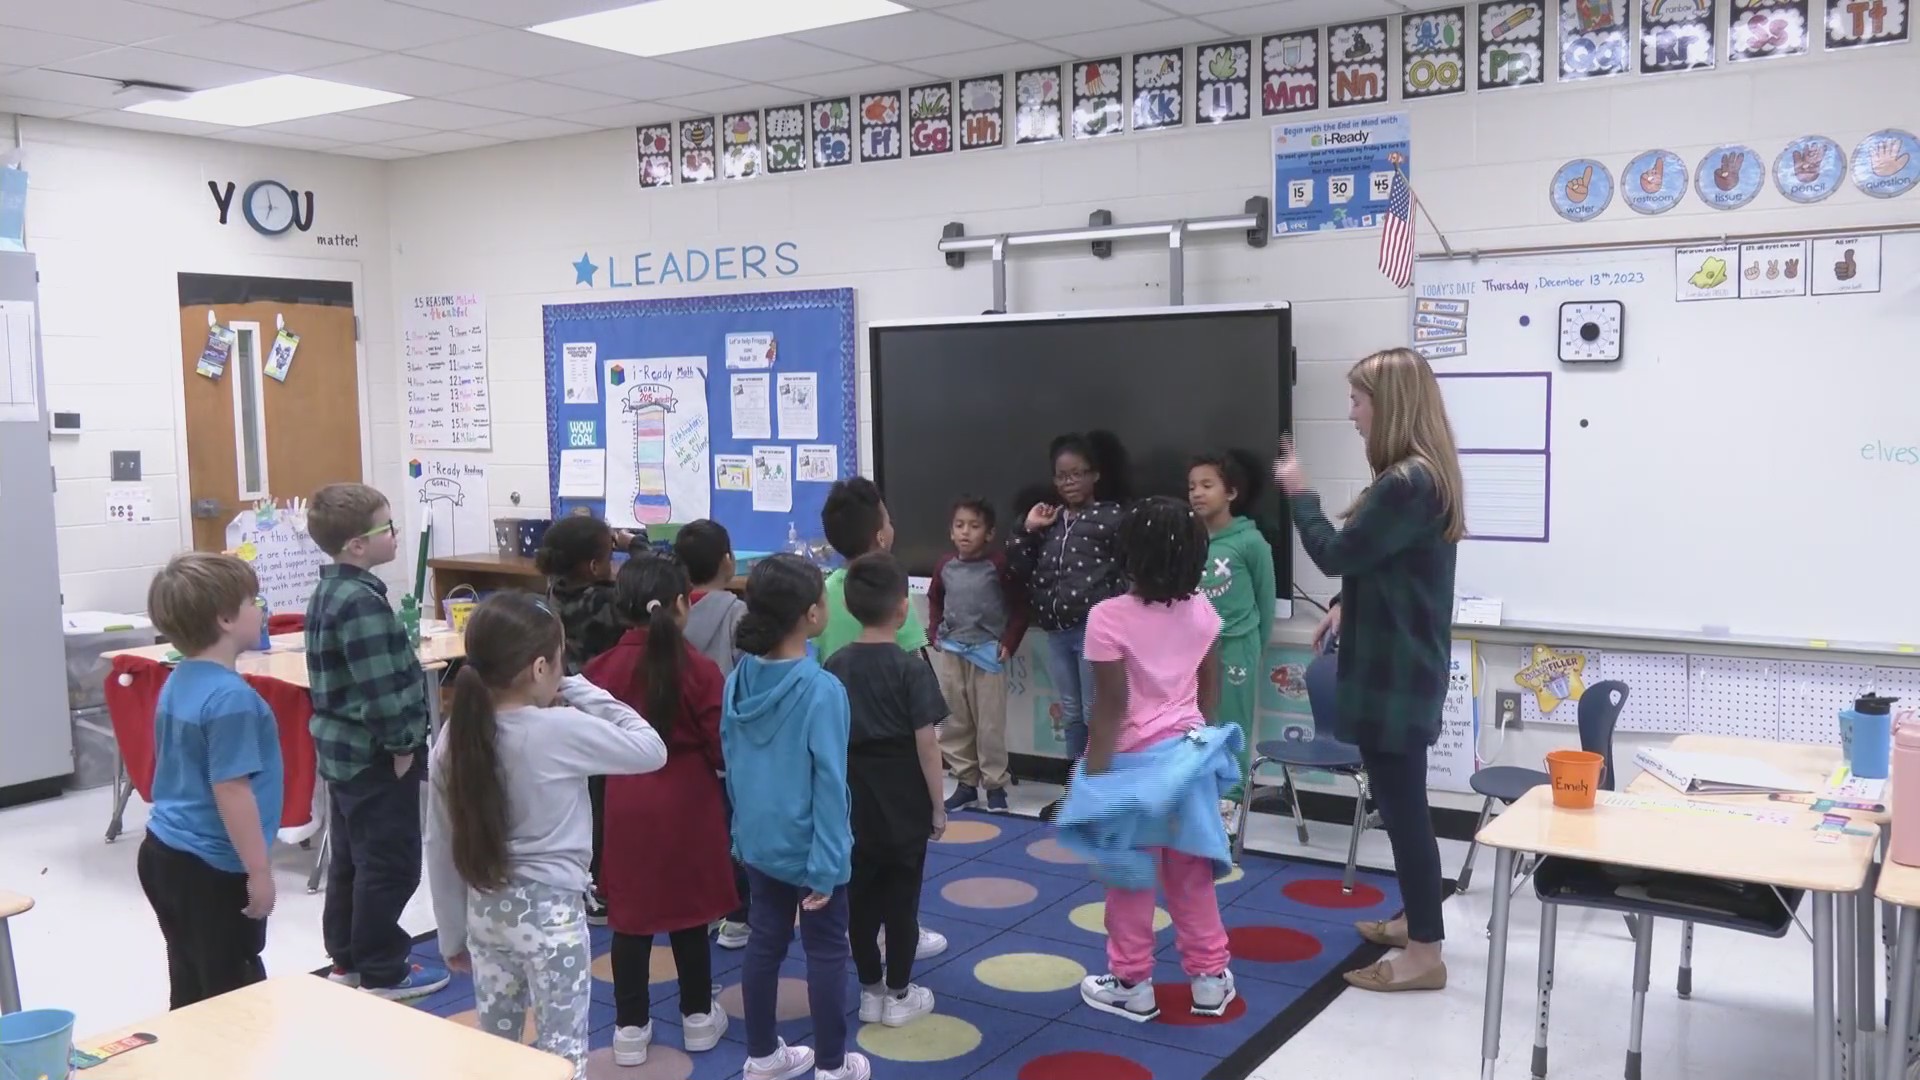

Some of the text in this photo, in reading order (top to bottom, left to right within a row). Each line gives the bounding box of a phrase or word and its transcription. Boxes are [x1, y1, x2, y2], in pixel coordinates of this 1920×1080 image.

[1665, 5, 1692, 14] rainbow
[1409, 60, 1458, 89] Oo
[1336, 68, 1378, 100] Nn
[1265, 80, 1315, 109] Mm
[966, 116, 997, 144] Hh
[1283, 126, 1304, 137] Begin
[1305, 124, 1322, 133] with
[1323, 122, 1336, 131] the
[1338, 120, 1351, 130] End
[1361, 117, 1379, 126] Mind
[1380, 115, 1398, 125] with
[870, 128, 892, 155] Ff
[913, 122, 948, 152] Gg
[1324, 130, 1370, 146] i-Ready
[1332, 182, 1347, 194] 30
[1374, 179, 1389, 191] 45
[1790, 183, 1825, 195] pencil
[1865, 176, 1911, 190] question
[1294, 187, 1304, 198] 15
[1633, 194, 1674, 203] restroom
[1715, 193, 1742, 202] tissue
[1566, 205, 1595, 214] water
[317, 234, 359, 247] matter!
[609, 241, 799, 288] LEADERS
[1422, 282, 1454, 297] TODAY'S
[1456, 281, 1476, 295] DATE
[1482, 279, 1529, 295] Thursday
[414, 297, 424, 309] 15
[425, 295, 454, 308] REASONS
[1434, 302, 1458, 312] Monday
[1432, 316, 1459, 328] Tuesday
[1435, 346, 1456, 354] Friday
[632, 365, 694, 381] i-Ready Math
[639, 393, 653, 402] 205
[569, 421, 594, 434] WOW
[571, 433, 596, 446] GOAL
[1860, 439, 1919, 465] elves
[428, 461, 461, 478] i-Ready
[252, 531, 266, 544] In
[271, 530, 288, 542] this
[267, 551, 280, 559] are
[284, 547, 307, 557] friends
[309, 545, 321, 554] wh
[270, 561, 282, 570] and
[285, 559, 307, 570] support
[276, 573, 286, 581] We
[288, 571, 305, 579] listen
[307, 569, 319, 577] and
[272, 583, 288, 591] with
[1548, 657, 1578, 672] FILLER
[1555, 776, 1589, 796] Emely
